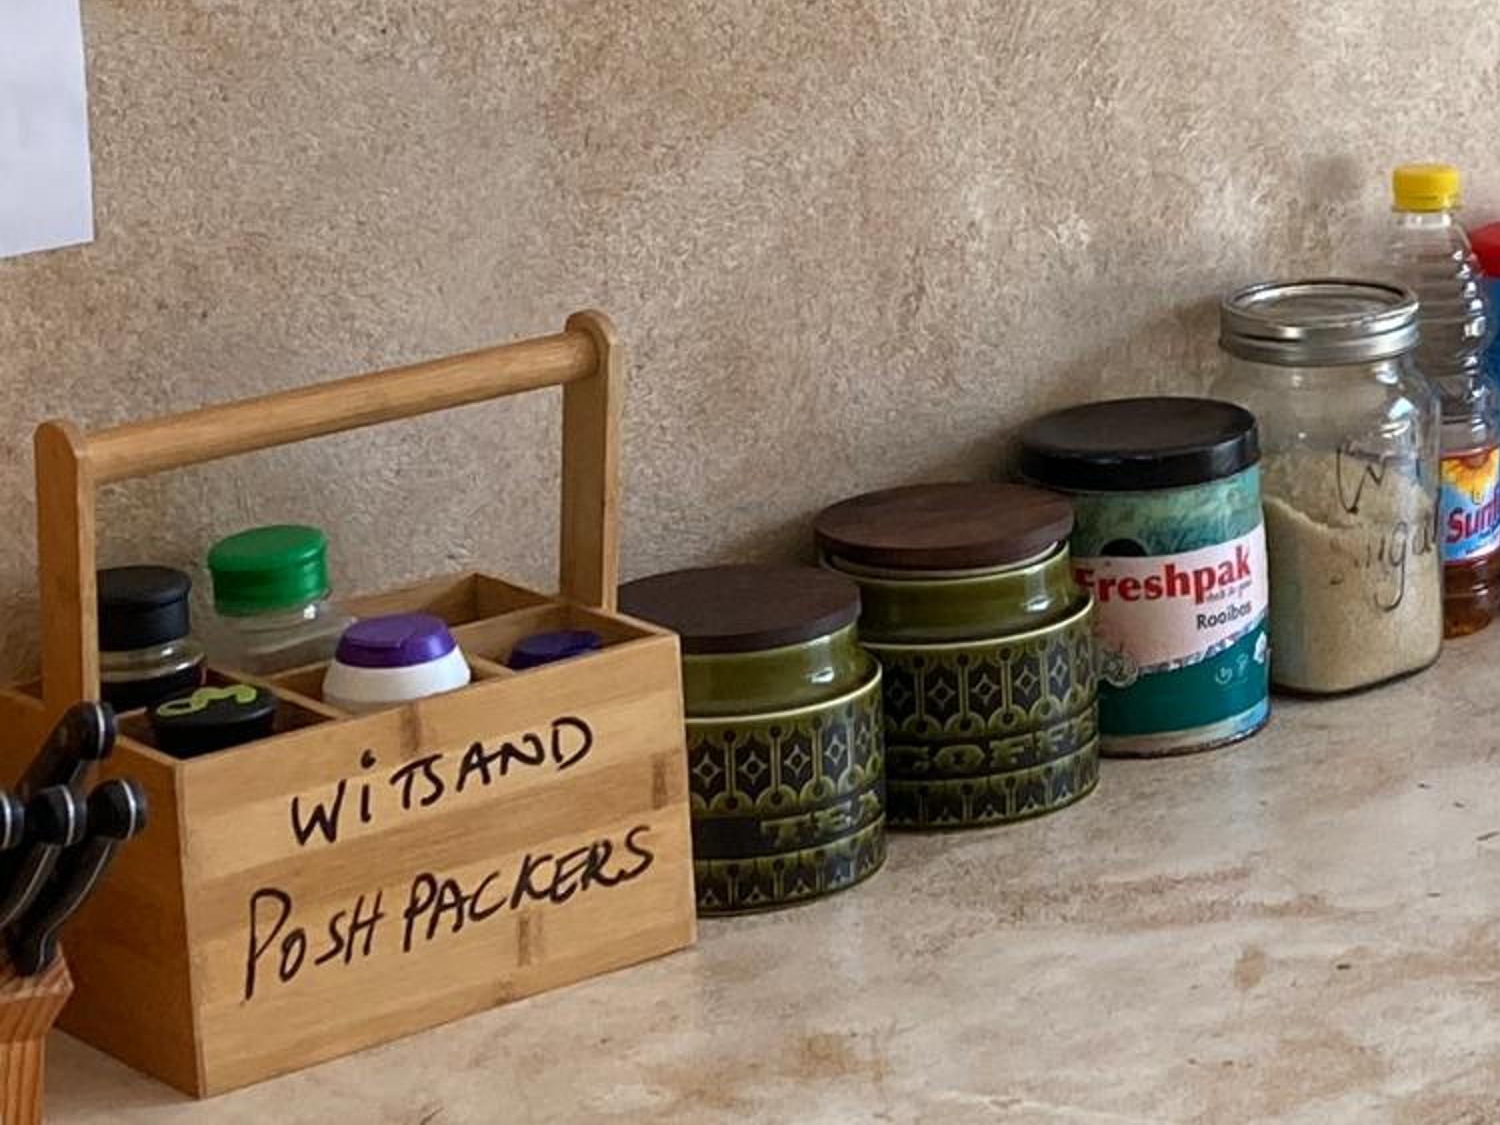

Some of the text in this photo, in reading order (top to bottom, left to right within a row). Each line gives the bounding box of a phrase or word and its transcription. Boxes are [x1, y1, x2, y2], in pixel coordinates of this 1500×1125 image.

[1073, 544, 1252, 605] Freshpak
[1196, 600, 1253, 631] Rooibos
[402, 825, 656, 953] PACKERS
